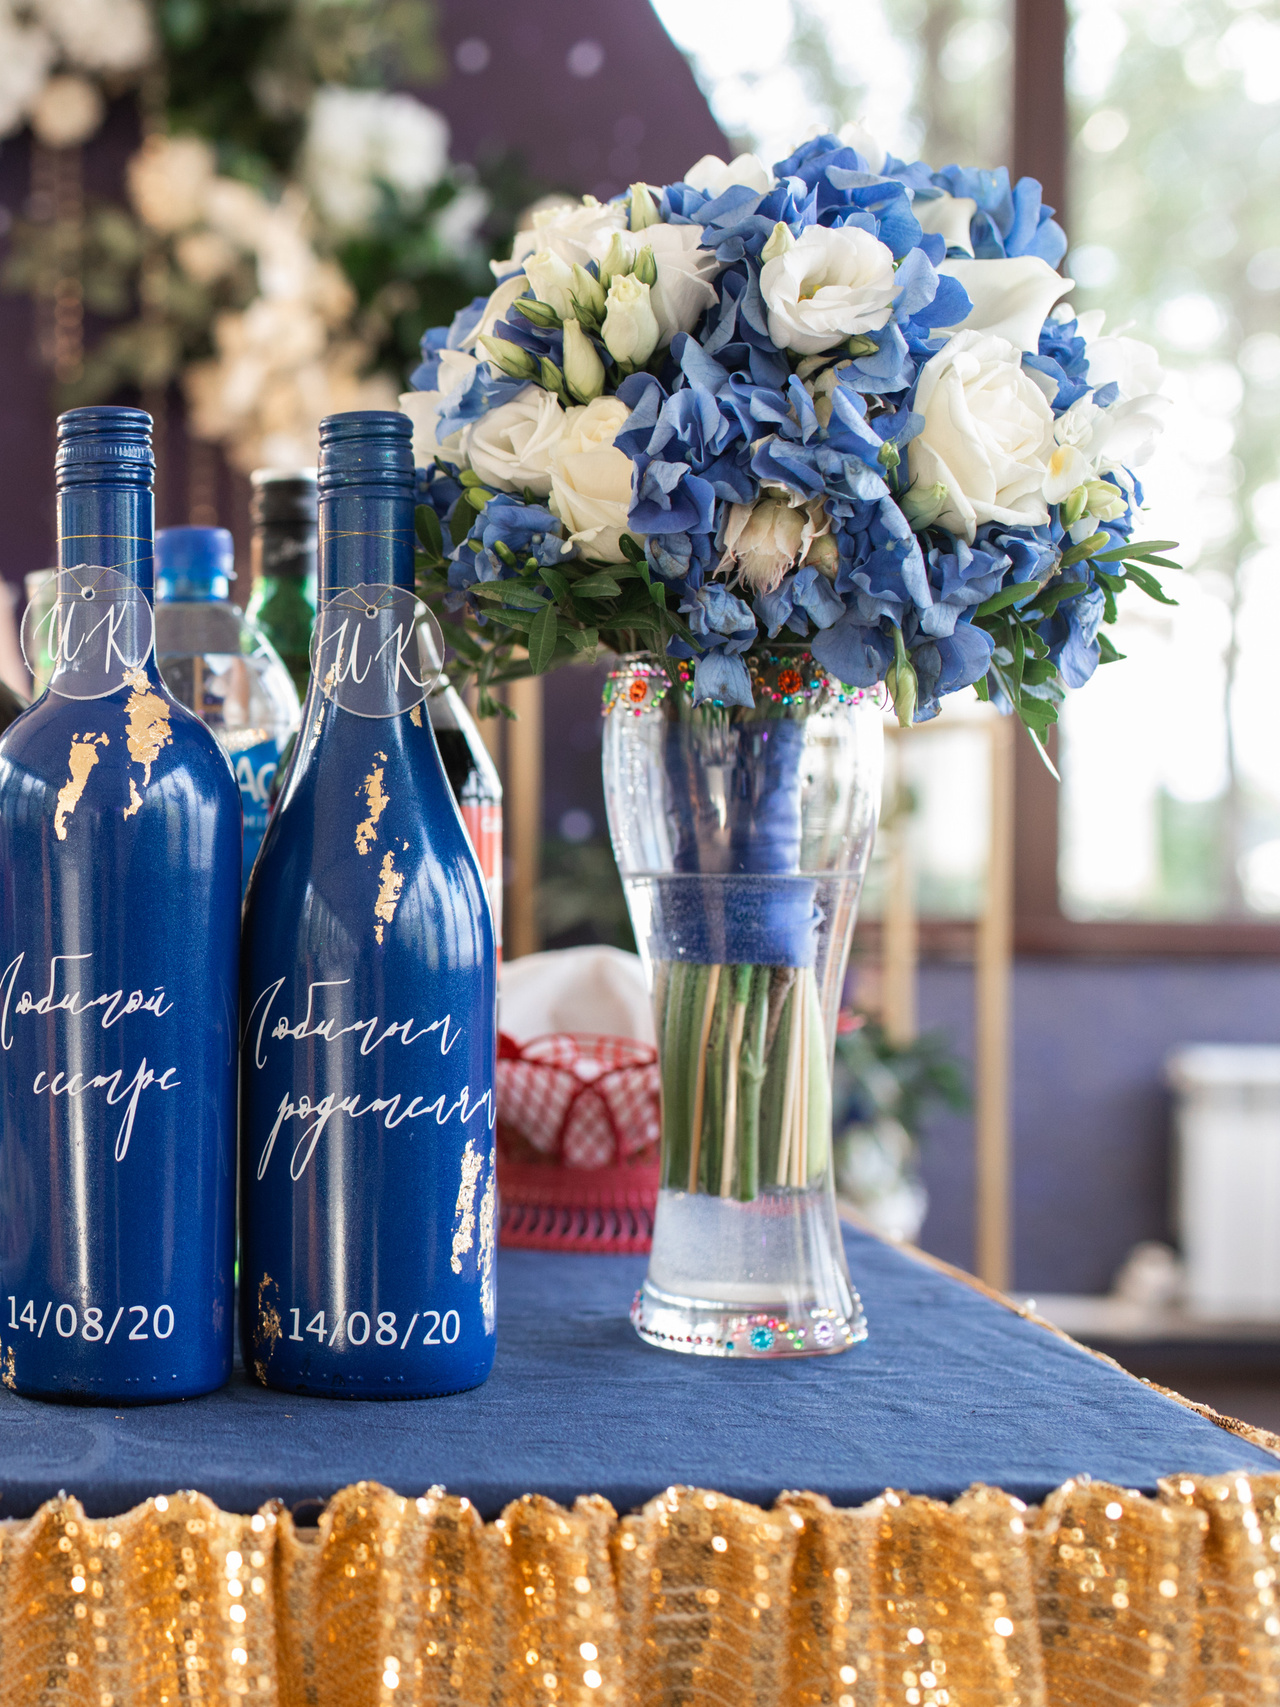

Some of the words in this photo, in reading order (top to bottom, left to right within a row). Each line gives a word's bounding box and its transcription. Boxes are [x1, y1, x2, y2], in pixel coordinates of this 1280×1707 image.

[33, 1057, 181, 1161] сестре
[7, 1296, 175, 1344] 14/08/20
[288, 1308, 461, 1349] 14/08/20
